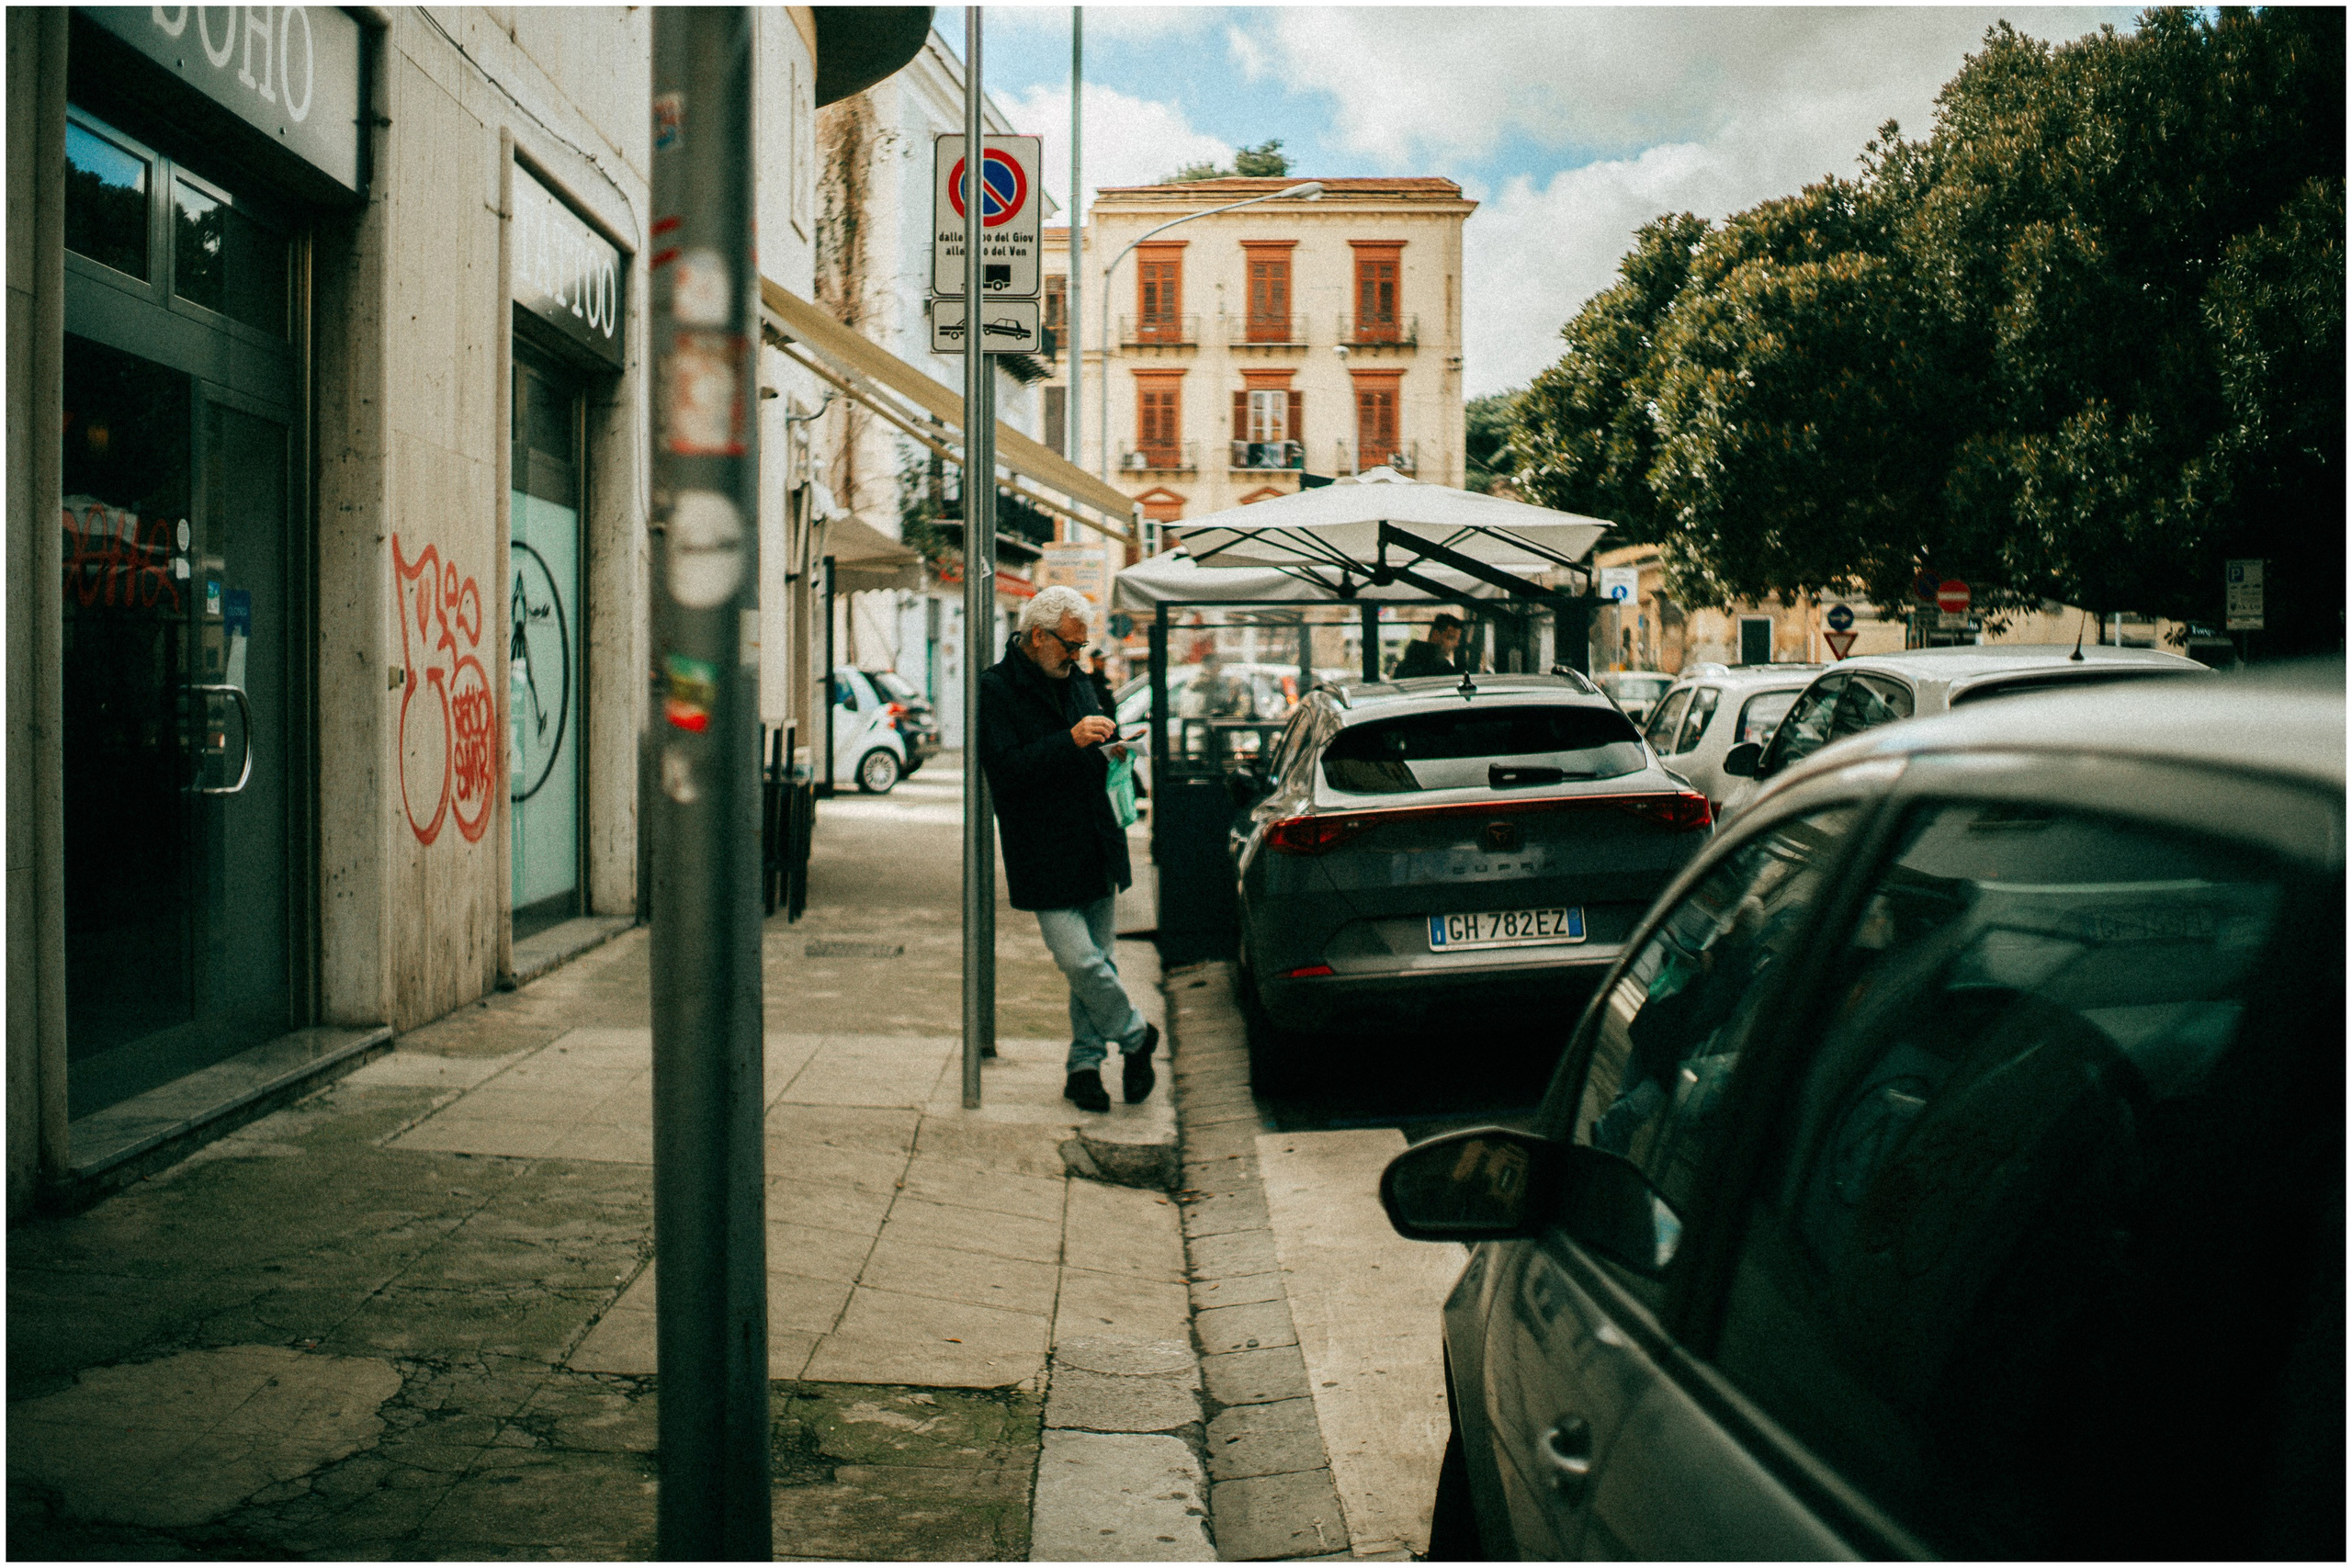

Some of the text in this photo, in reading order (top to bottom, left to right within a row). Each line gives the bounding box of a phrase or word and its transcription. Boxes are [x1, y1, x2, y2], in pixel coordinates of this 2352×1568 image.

[153, 6, 313, 122] OHO
[939, 231, 964, 243] dalle
[995, 232, 1010, 243] del
[1012, 232, 1034, 243] Giov
[946, 245, 965, 256] alle
[991, 246, 1006, 256] del
[1010, 246, 1027, 256] Ven
